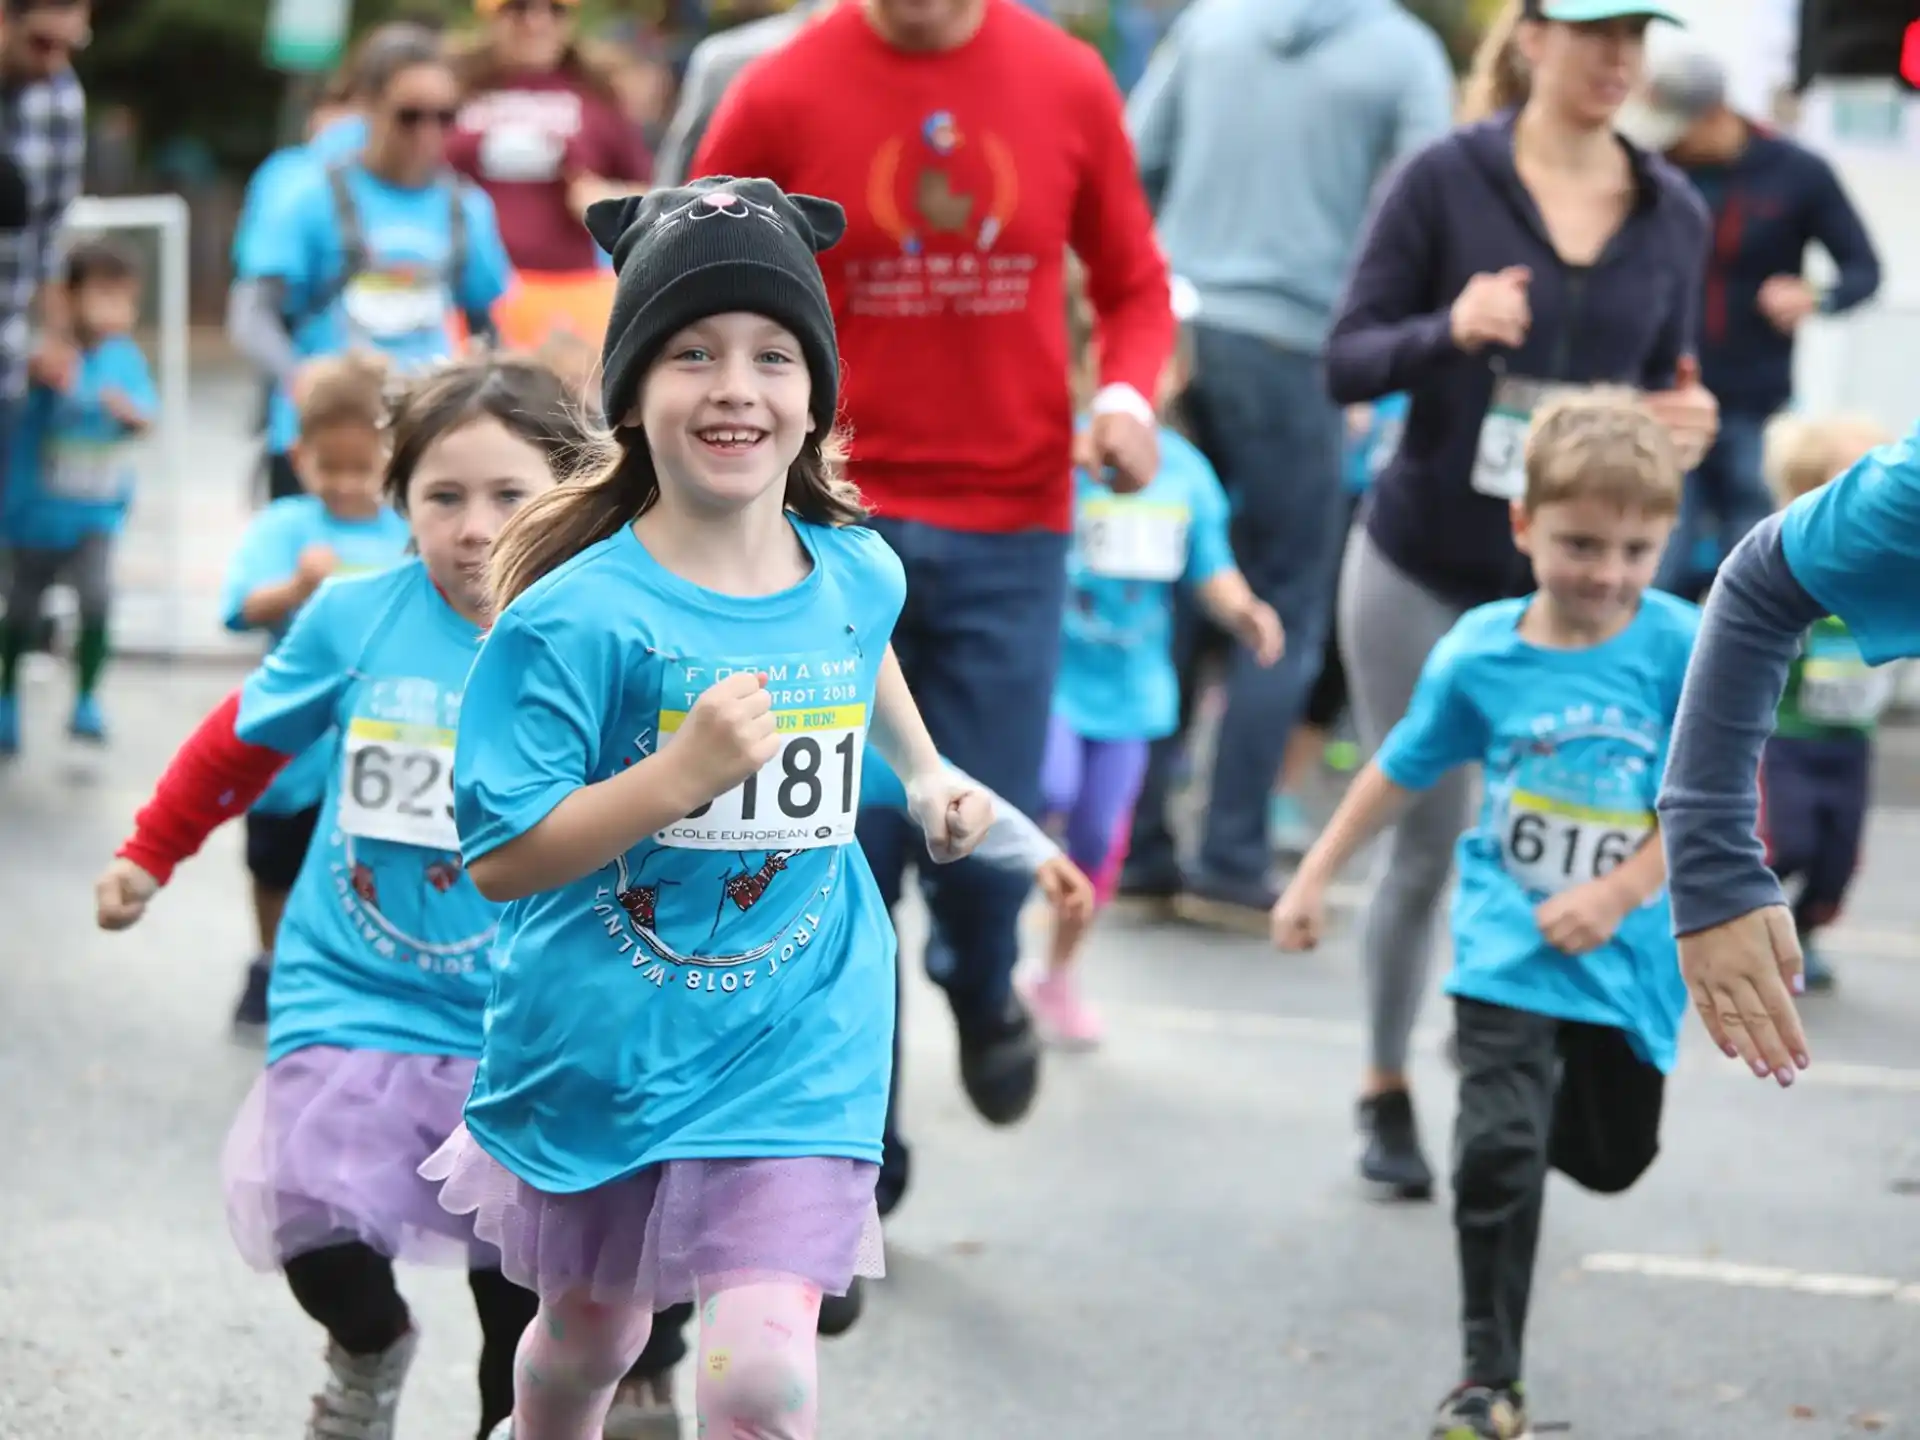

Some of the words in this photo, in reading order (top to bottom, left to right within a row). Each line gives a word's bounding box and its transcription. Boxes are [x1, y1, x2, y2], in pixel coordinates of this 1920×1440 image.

[821, 660, 857, 677] GYM
[772, 688, 816, 704] TROT
[823, 685, 857, 701] 2018
[803, 712, 836, 727] RUN!
[351, 745, 455, 820] 62
[683, 732, 854, 820] 181
[671, 828, 717, 840] COLE
[721, 828, 808, 840] EUROPEAN
[593, 885, 666, 987] WALNUT
[768, 912, 821, 977] TROT
[686, 968, 757, 992] 2018
